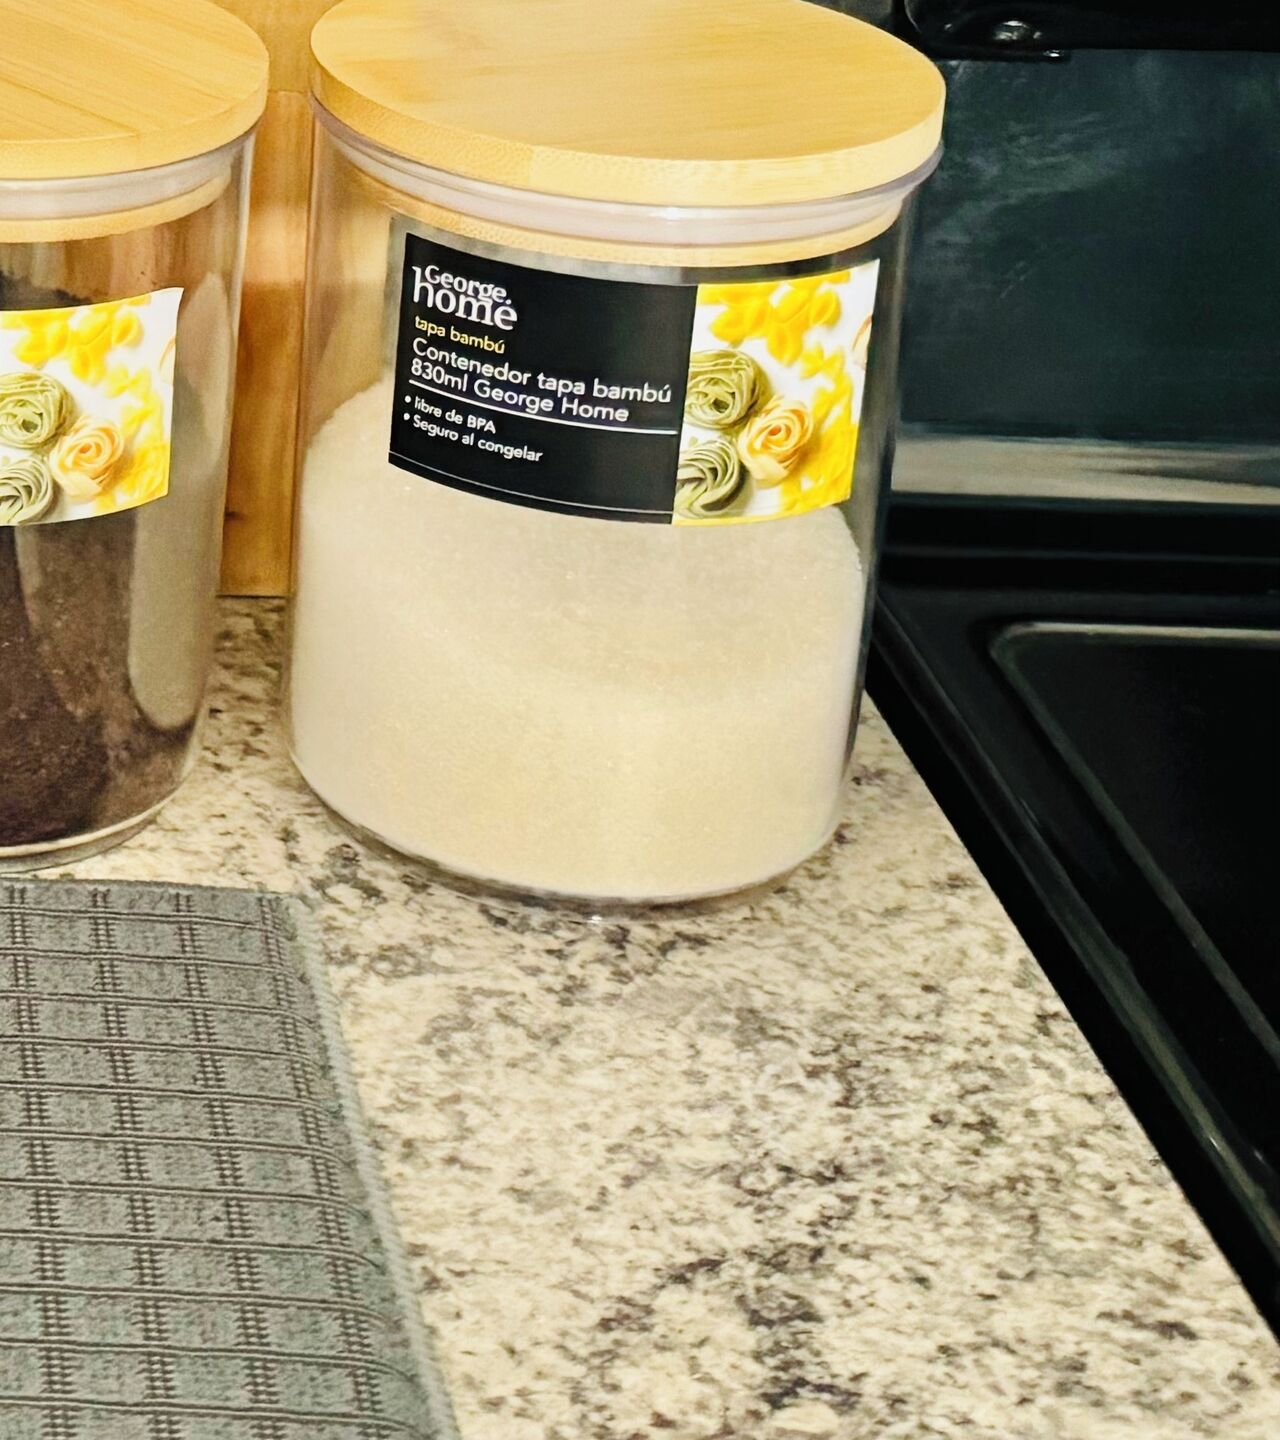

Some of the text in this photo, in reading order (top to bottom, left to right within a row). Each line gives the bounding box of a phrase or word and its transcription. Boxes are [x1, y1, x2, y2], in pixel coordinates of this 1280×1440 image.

[412, 265, 518, 331] home
[415, 315, 505, 354] tapa bambú
[411, 357, 630, 422] 830ml George Home
[412, 337, 672, 403] Contenedor tapa bambú
[413, 414, 544, 462] Seguro al congelar
[414, 395, 496, 434] libre de BPA
